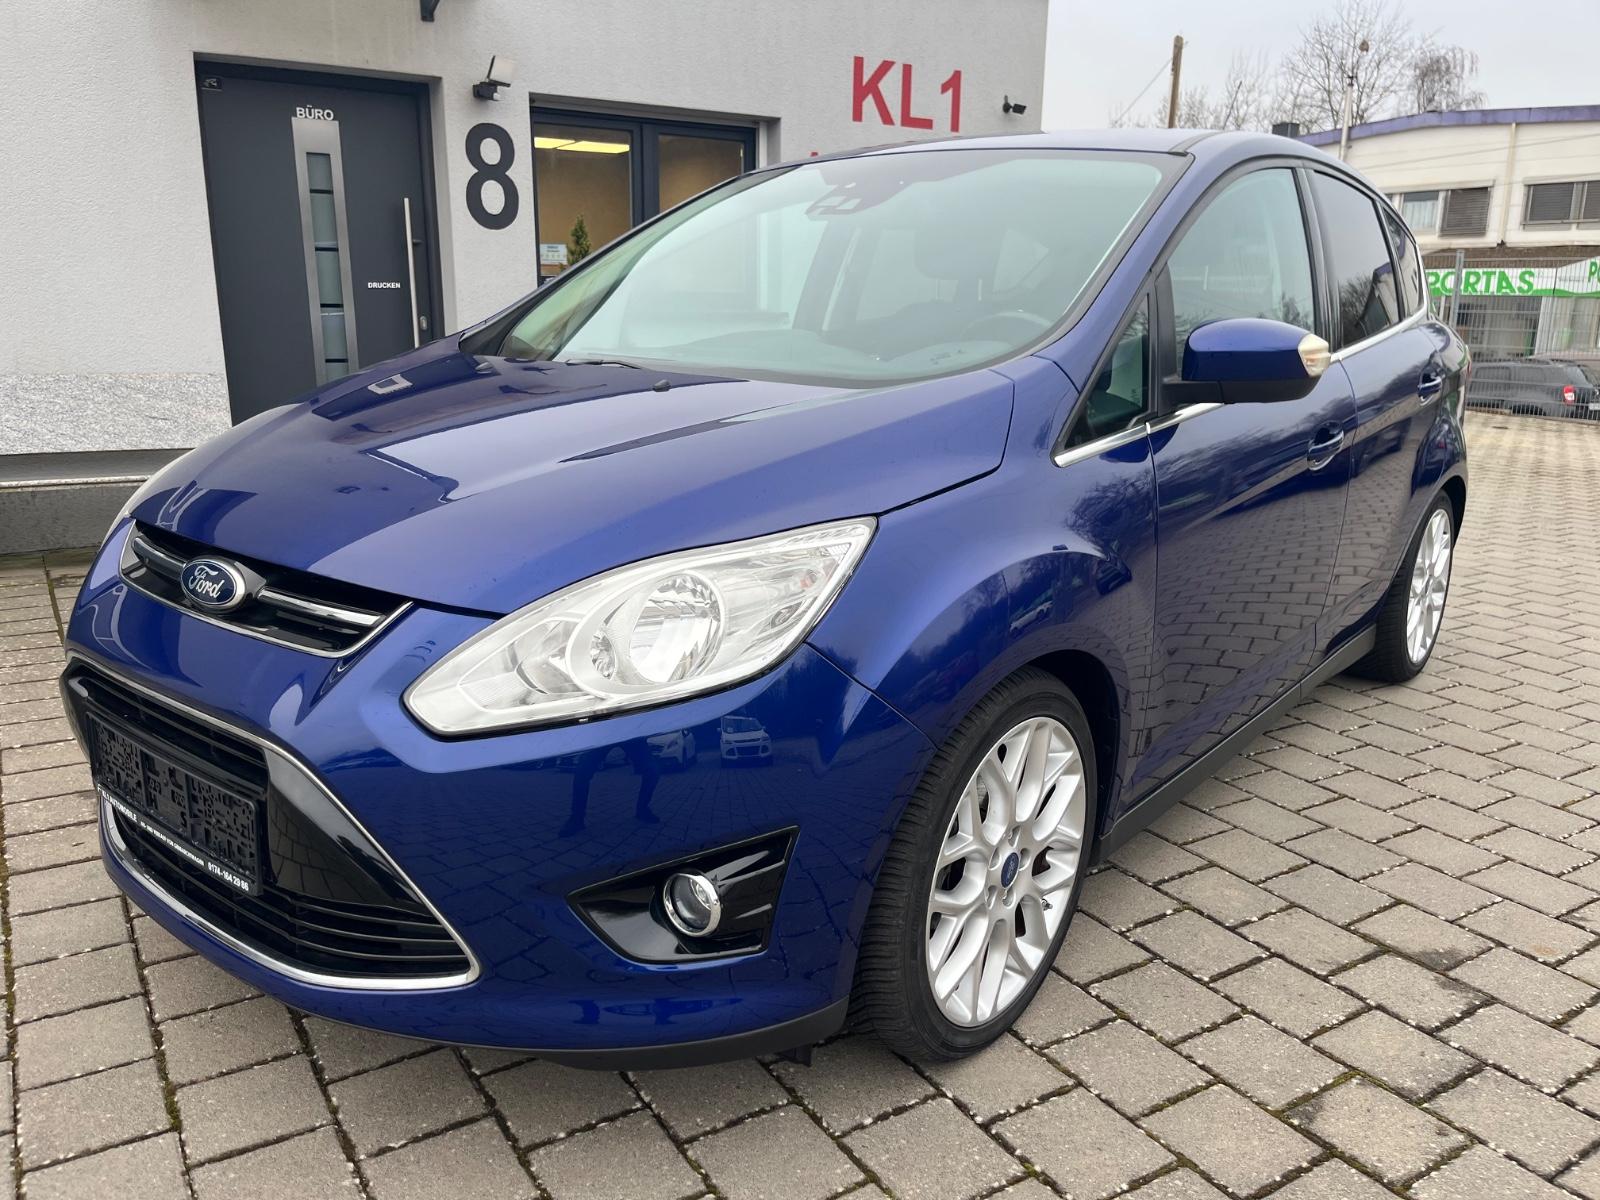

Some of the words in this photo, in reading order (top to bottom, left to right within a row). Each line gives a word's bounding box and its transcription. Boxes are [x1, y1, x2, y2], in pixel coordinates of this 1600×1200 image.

[851, 56, 963, 133] KL1
[296, 104, 334, 121] BÜRO
[465, 123, 520, 230] 8
[367, 281, 401, 289] DRUCKEN
[1426, 269, 1536, 295] PORTAS
[188, 565, 225, 598] Ford
